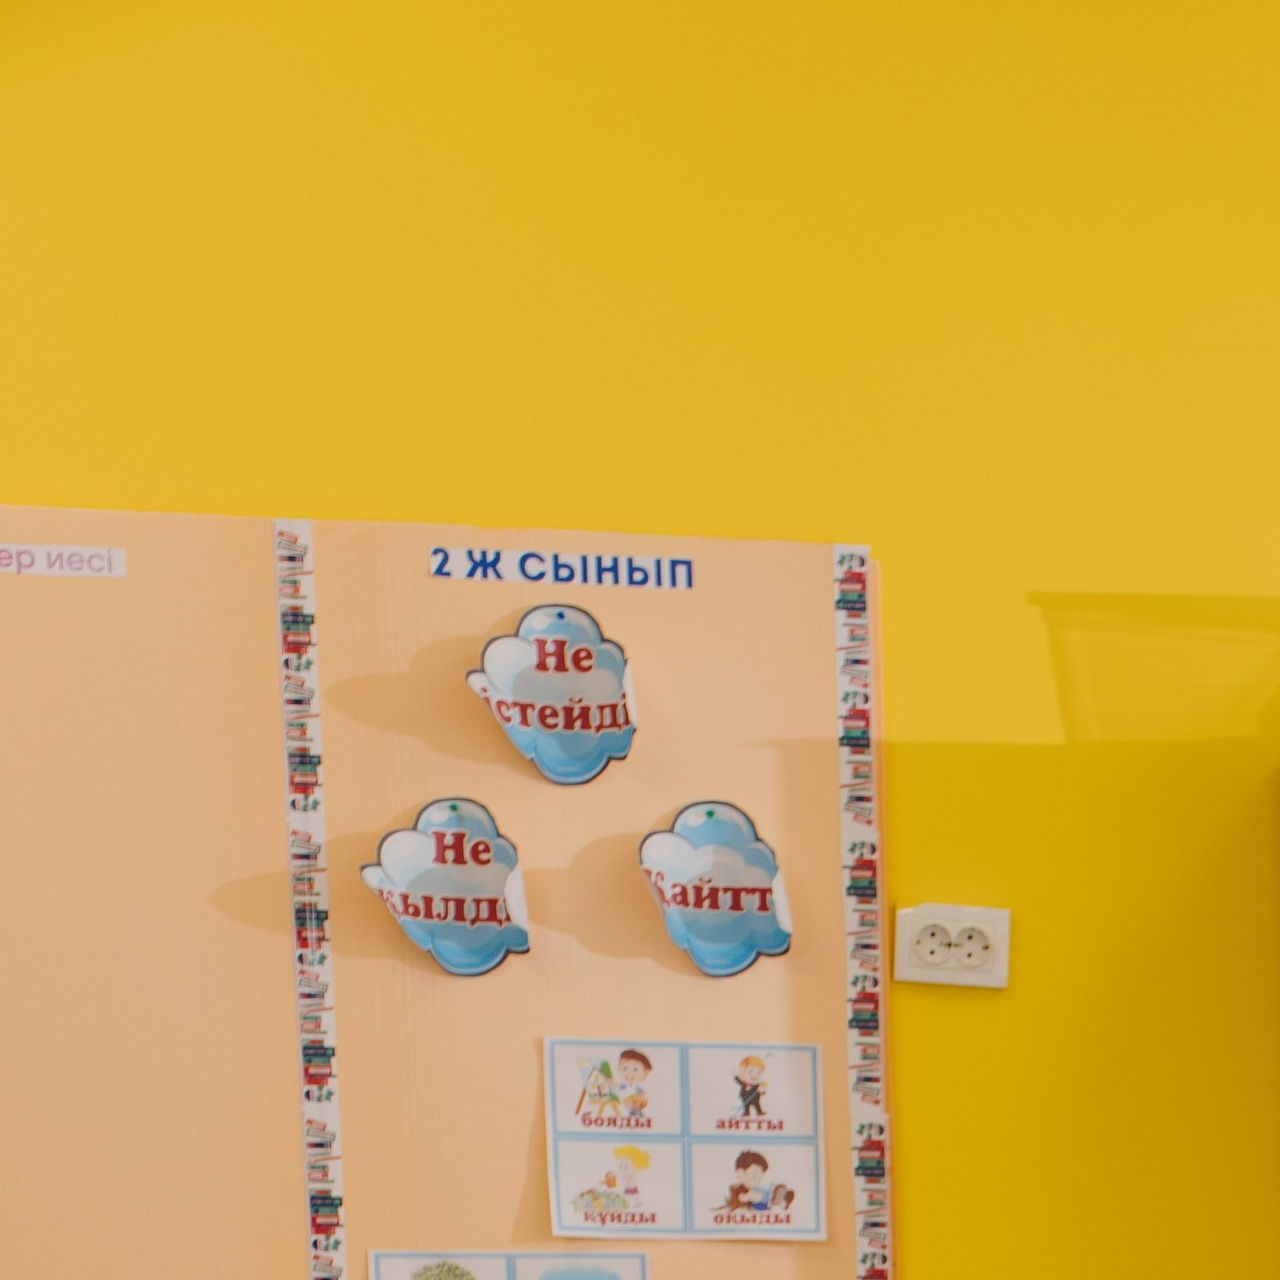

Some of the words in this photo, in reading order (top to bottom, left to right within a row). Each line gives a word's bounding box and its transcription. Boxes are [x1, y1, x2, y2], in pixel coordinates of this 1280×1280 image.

[46, 548, 113, 573] иесі
[431, 548, 450, 577] 2
[466, 549, 502, 580] Ж
[518, 551, 694, 589] СЫНЫП
[534, 638, 594, 673] Не
[432, 831, 492, 866] Не
[643, 868, 773, 912] Қайтт
